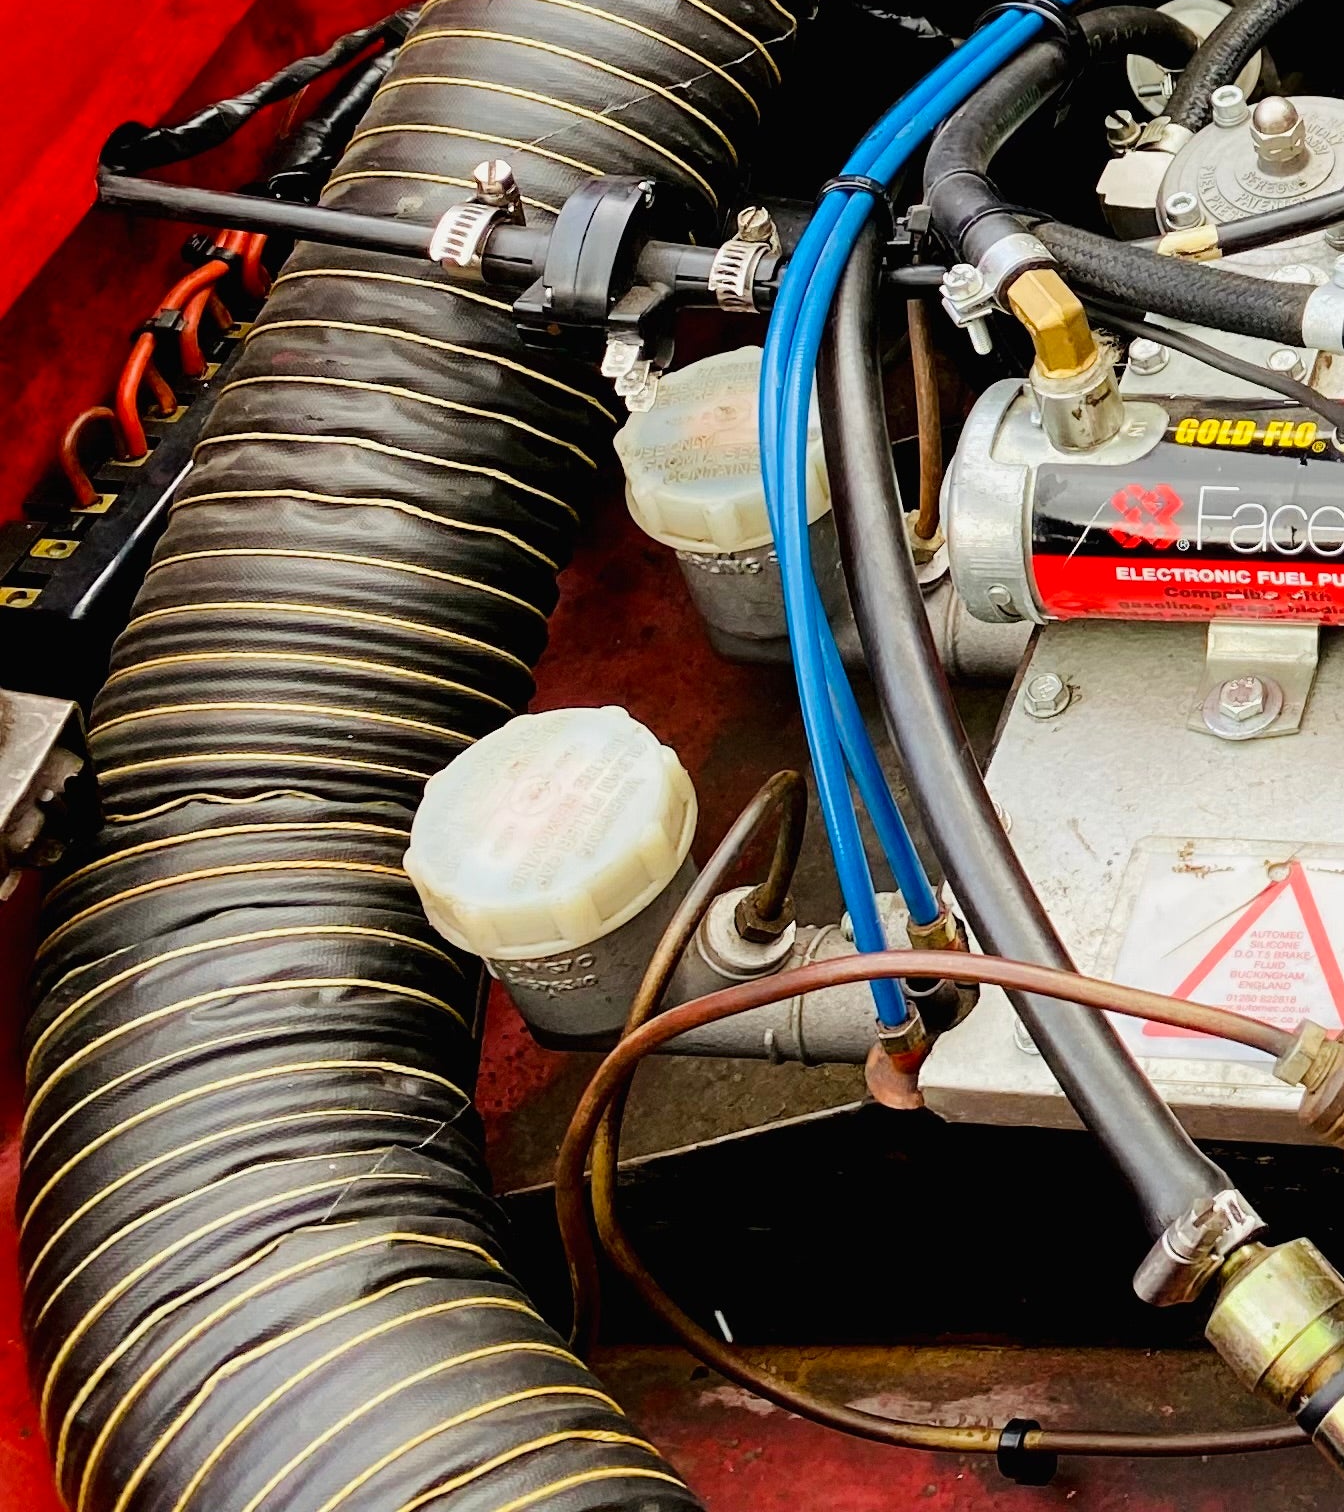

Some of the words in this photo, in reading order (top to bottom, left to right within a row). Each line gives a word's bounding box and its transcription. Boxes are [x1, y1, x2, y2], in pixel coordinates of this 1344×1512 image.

[1115, 567, 1251, 585] ELECTRONIC
[1258, 571, 1313, 586] FUEL
[1250, 930, 1304, 940] AUTOMEC
[1249, 940, 1301, 950] SILICONE
[1273, 951, 1312, 961] BRAKE
[1254, 960, 1287, 970] FLUID
[1229, 970, 1306, 980] BUCKINGHAM
[1238, 980, 1292, 991] ENGLAND
